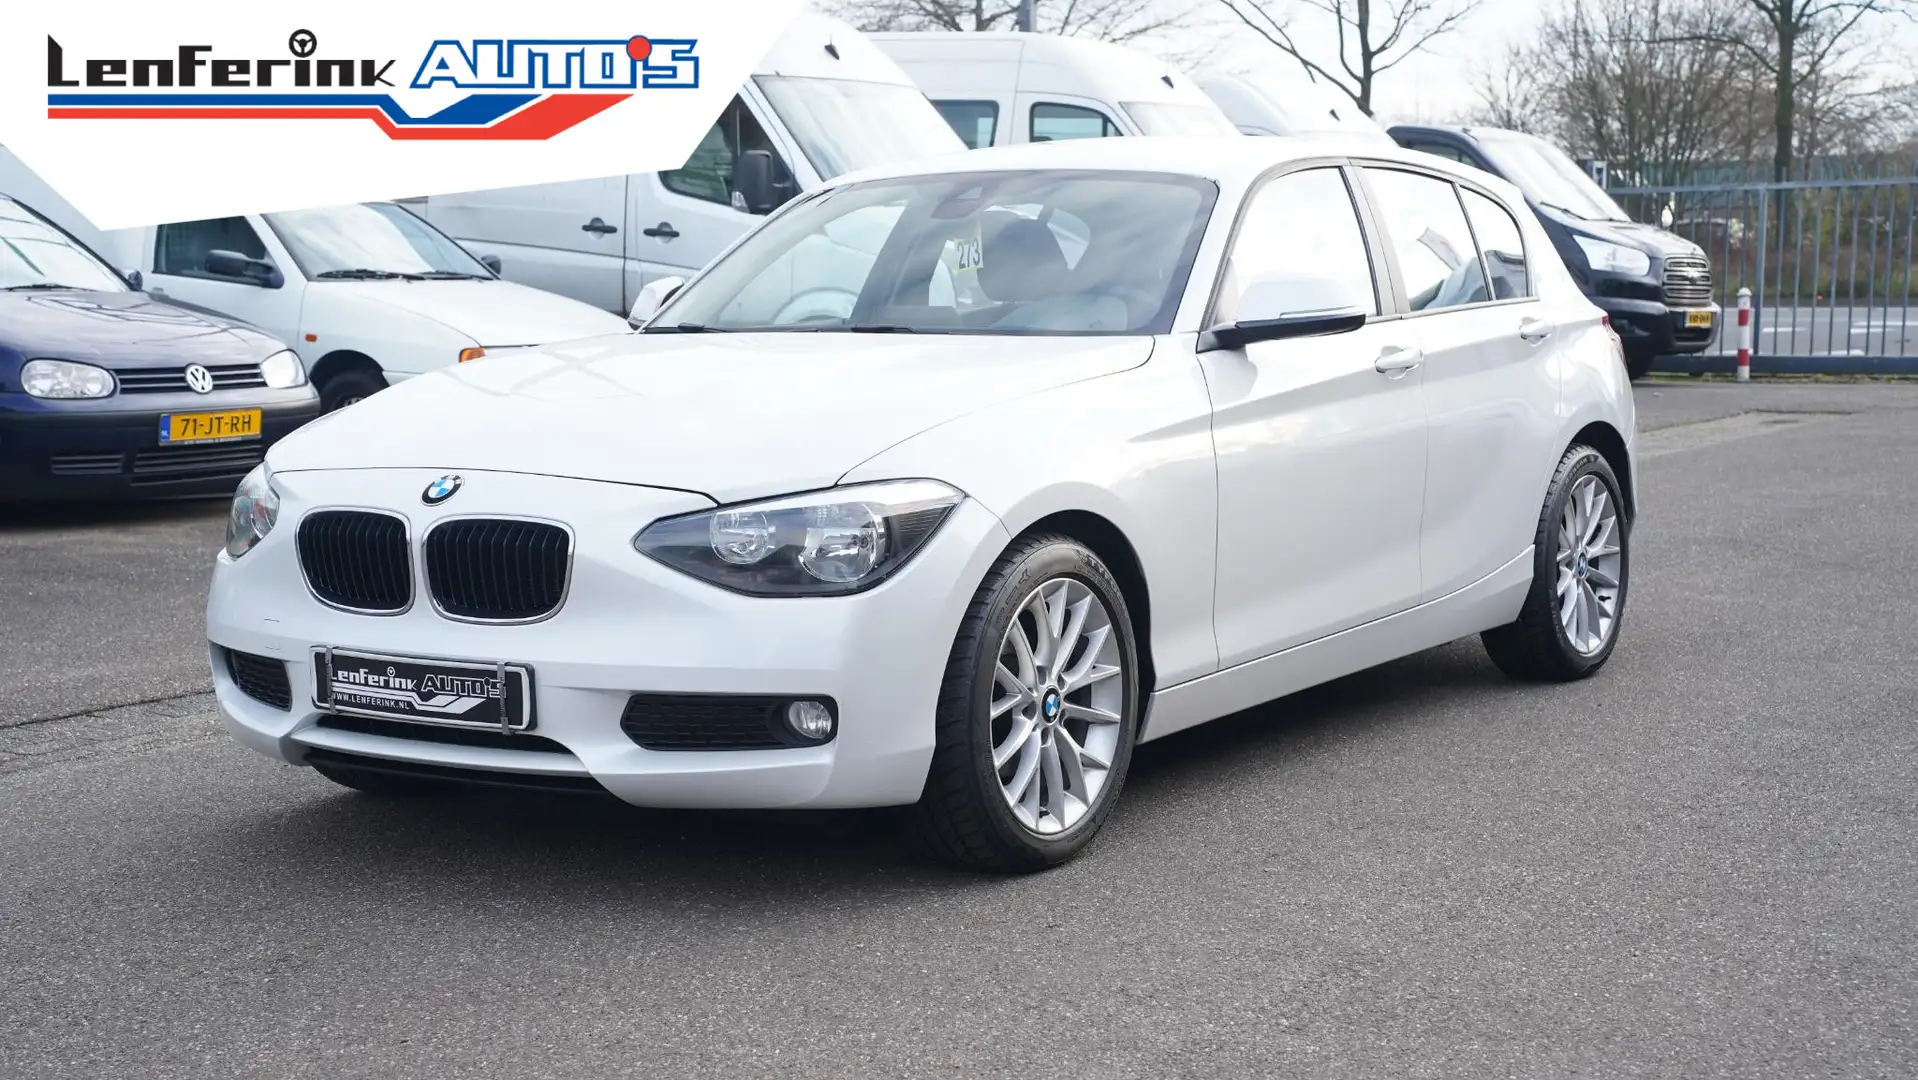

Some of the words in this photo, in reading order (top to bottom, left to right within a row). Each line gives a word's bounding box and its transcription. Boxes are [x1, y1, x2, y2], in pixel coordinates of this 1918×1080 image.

[957, 238, 981, 269] 273
[180, 414, 252, 436] 71-JT-RH
[420, 674, 507, 698] AUTO'S
